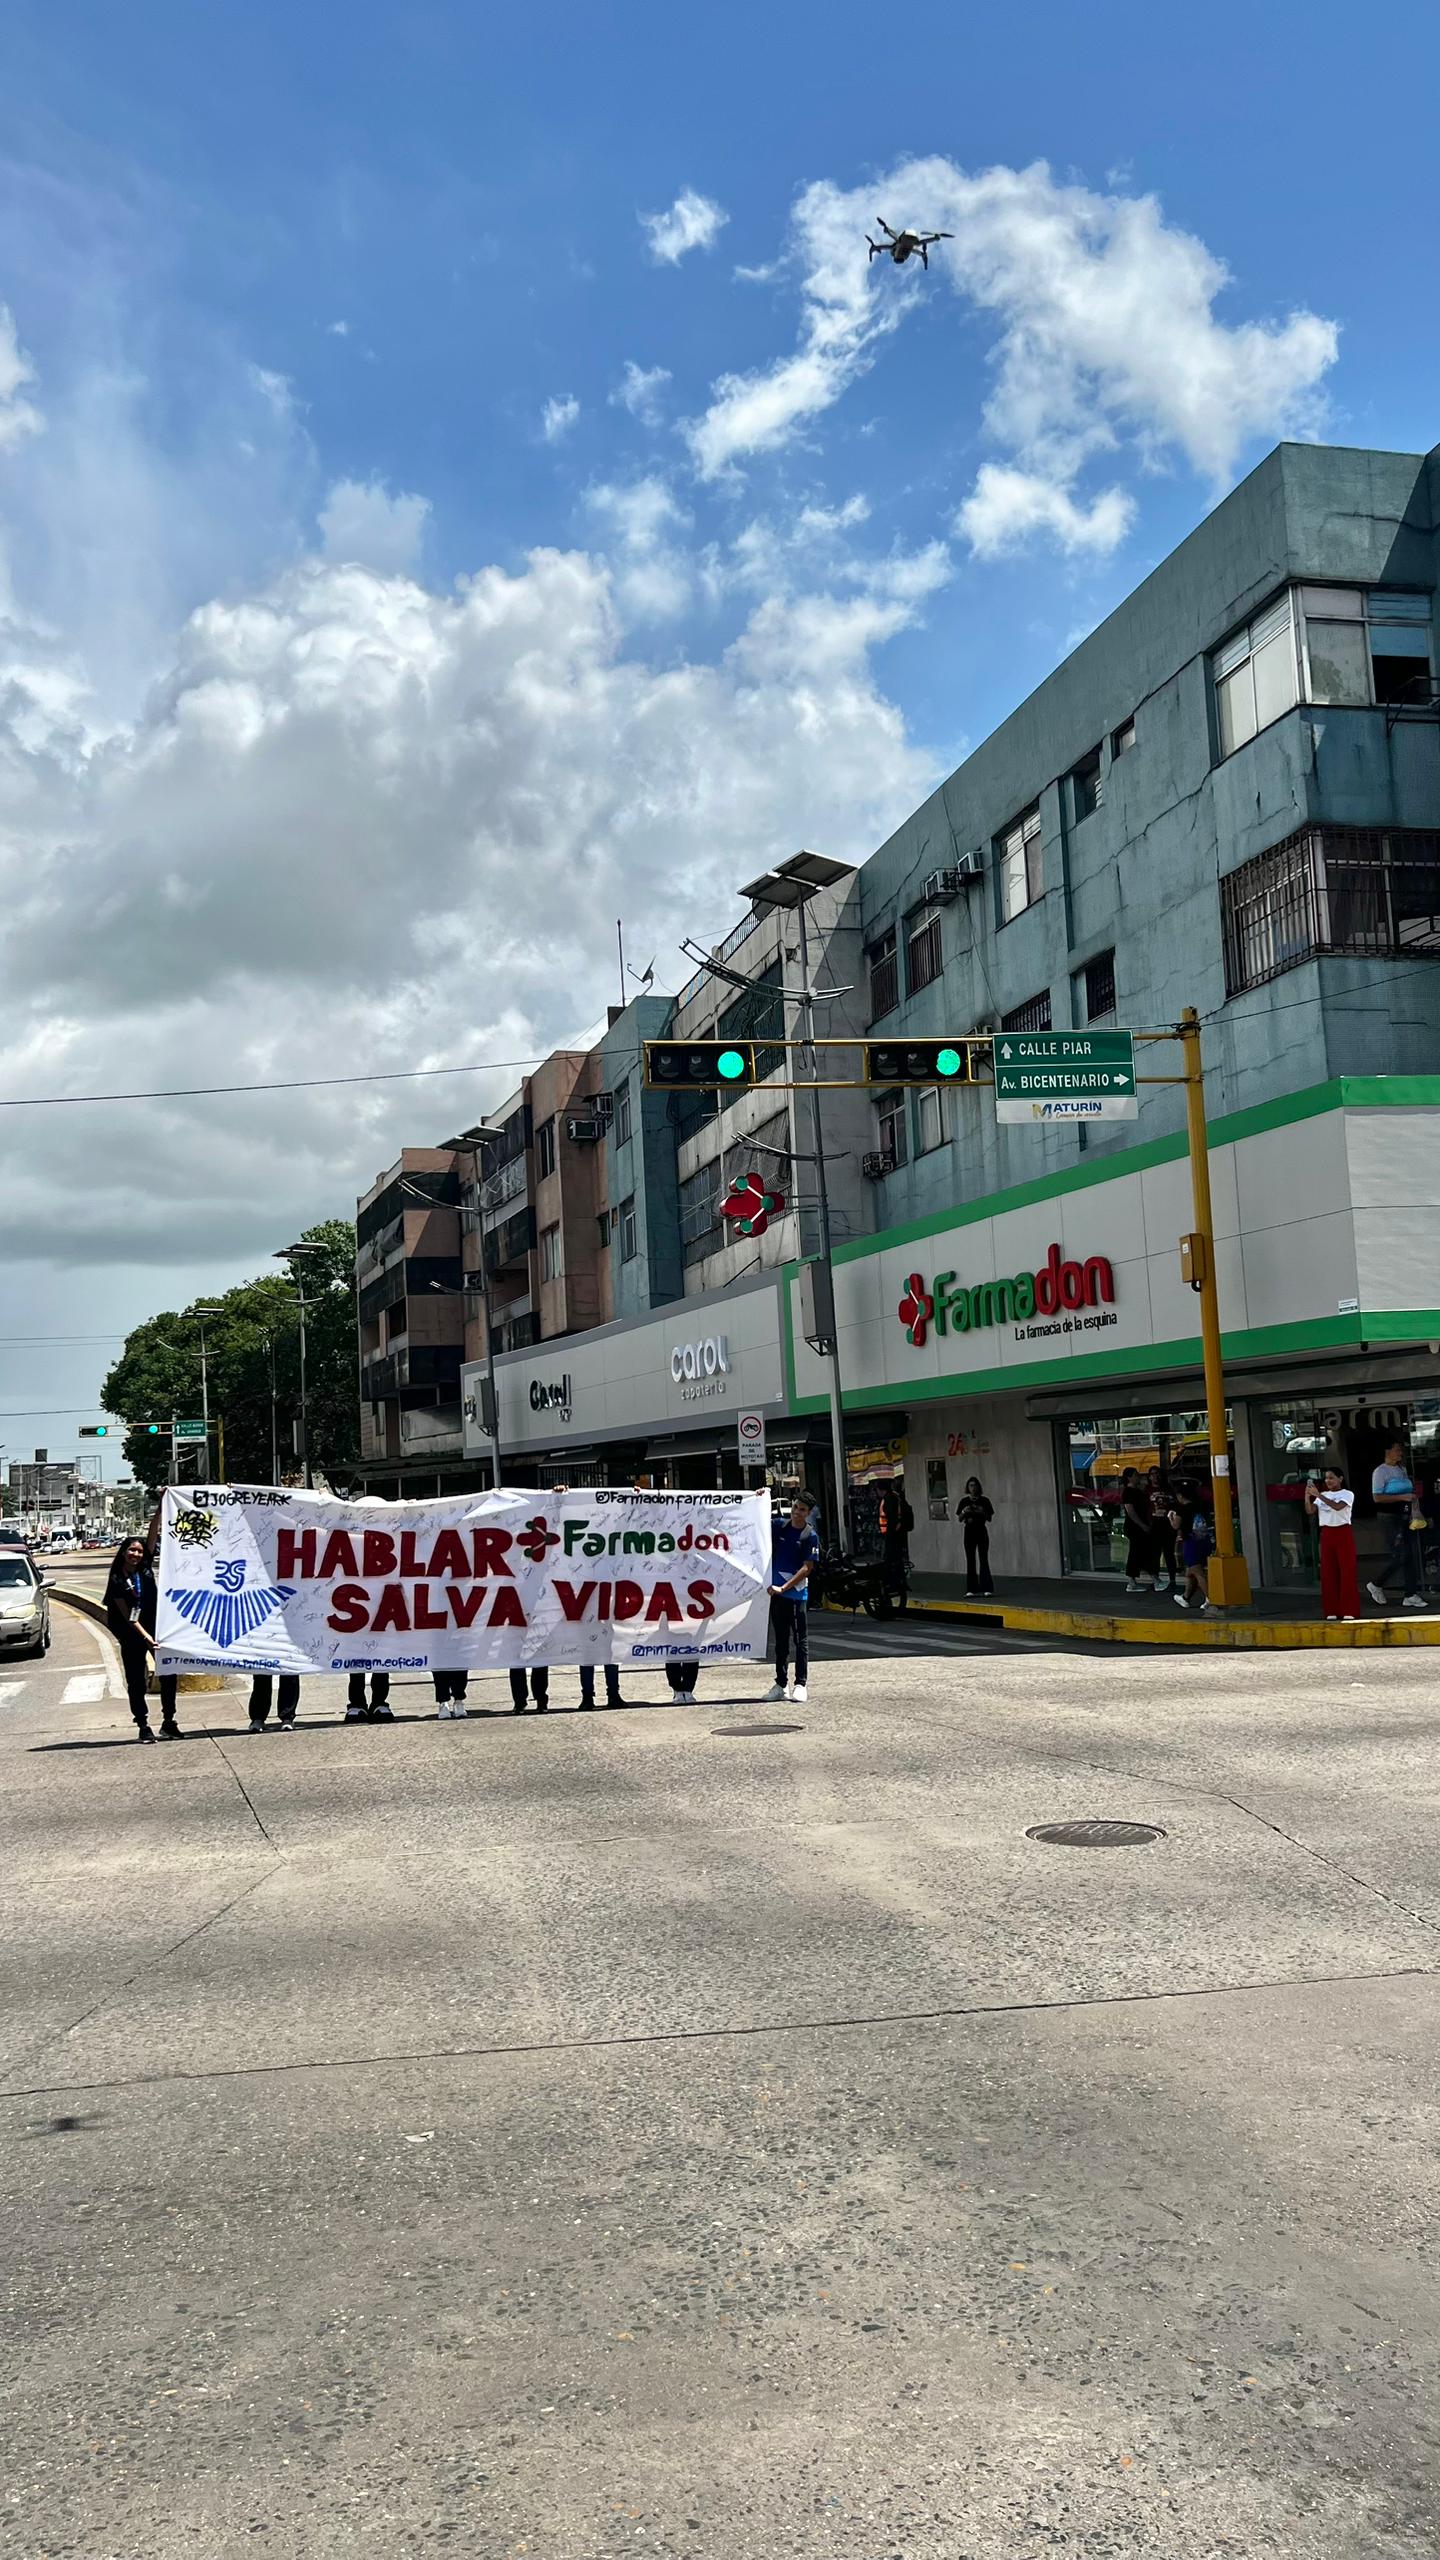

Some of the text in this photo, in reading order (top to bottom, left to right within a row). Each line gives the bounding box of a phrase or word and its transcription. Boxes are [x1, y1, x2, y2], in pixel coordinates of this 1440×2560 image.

[1018, 1041, 1092, 1055] CALLE PIAR
[1001, 1073, 1110, 1090] Av. BICENTENARIO
[933, 1243, 1115, 1336] Farmadon
[1014, 1311, 1118, 1341] La farmacia de la esquina
[671, 1335, 730, 1382] carol
[277, 1528, 515, 1580] HABLAR
[563, 1519, 729, 1557] Farmadon
[327, 1579, 716, 1633] SALVA VIDAS
